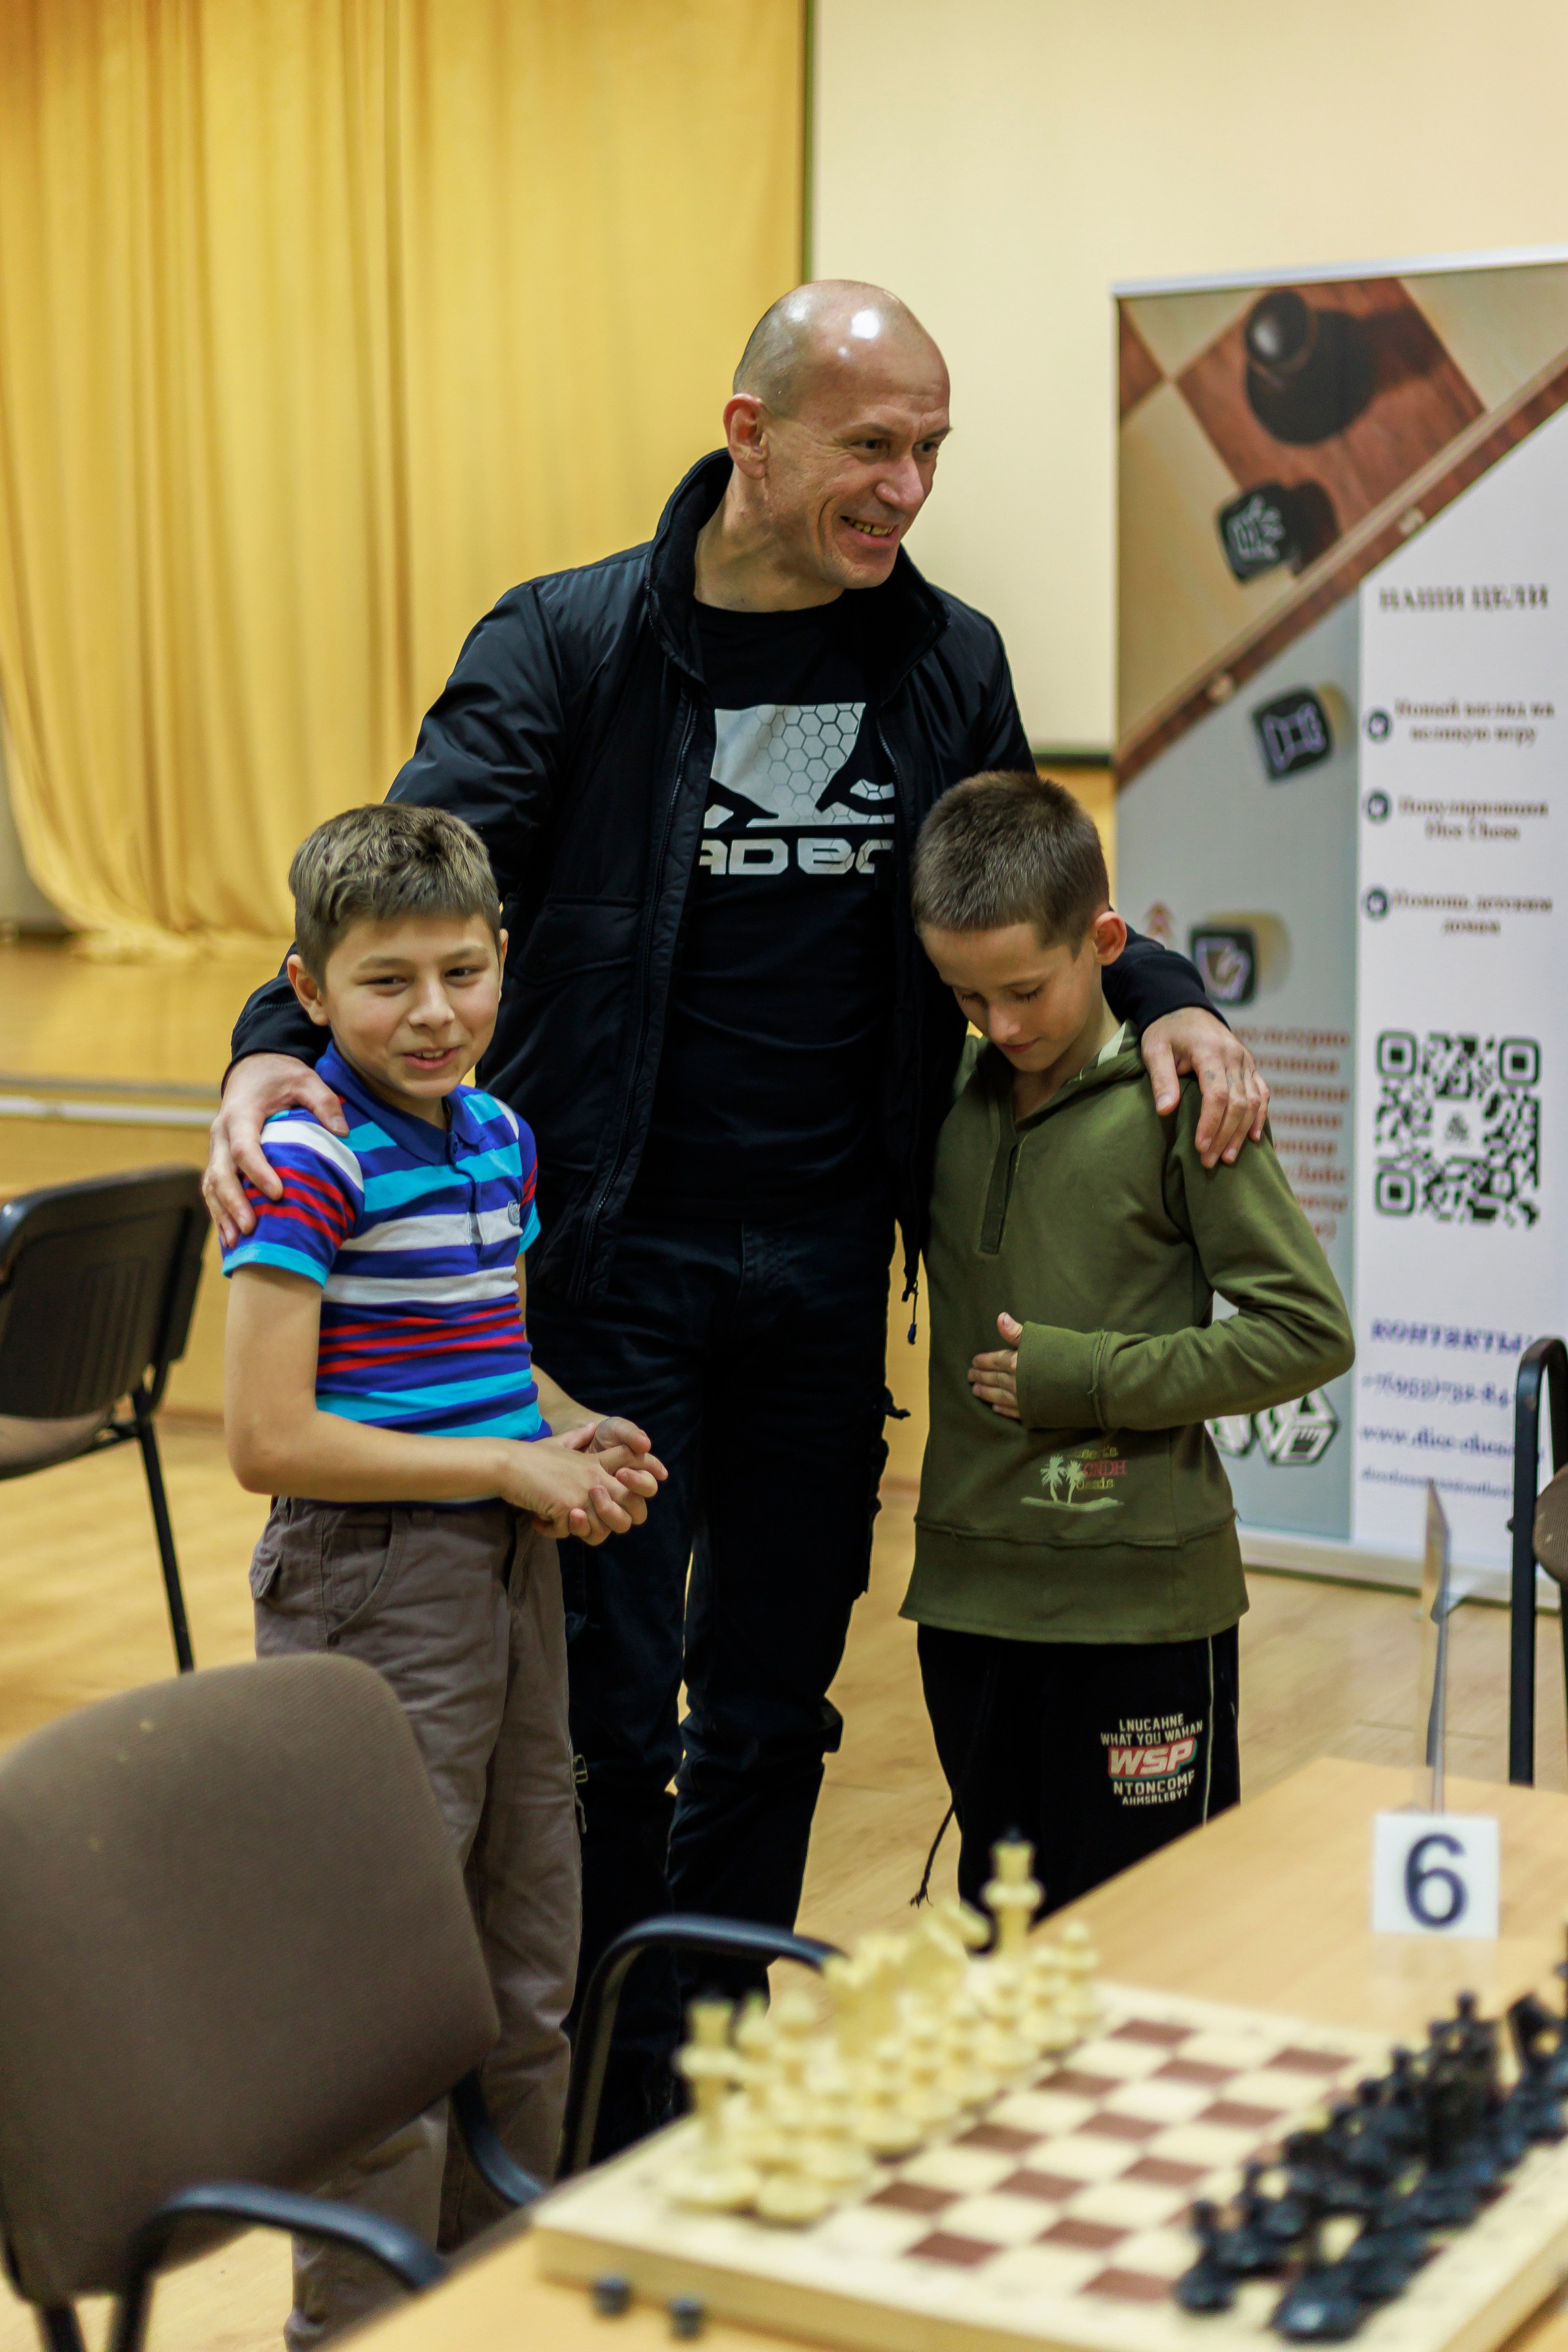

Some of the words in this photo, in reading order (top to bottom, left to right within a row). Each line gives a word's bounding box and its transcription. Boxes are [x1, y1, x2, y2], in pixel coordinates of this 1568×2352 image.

[1100, 1732, 1133, 1746] WHAT
[1137, 1732, 1161, 1746] YOU
[1110, 1739, 1194, 1776] WSP
[1405, 1831, 1469, 1931] 6
